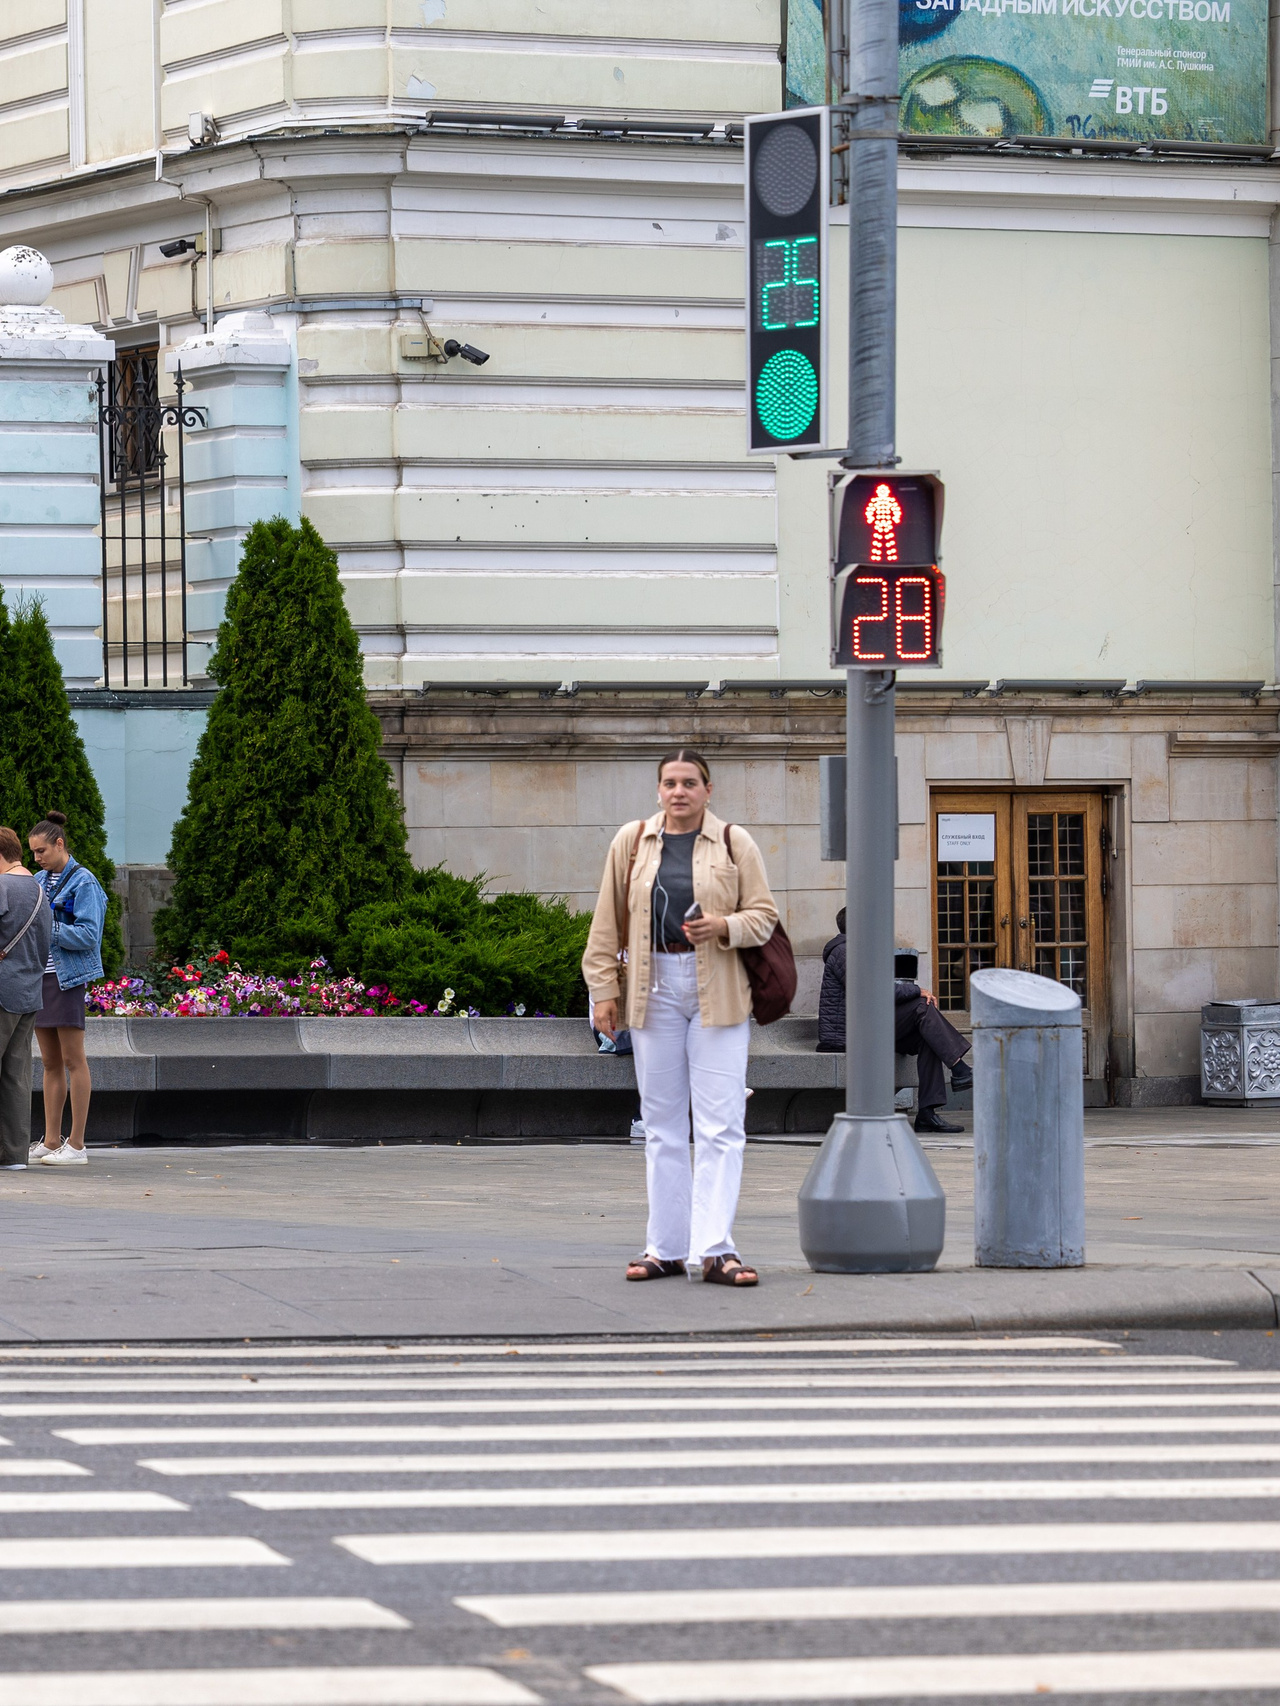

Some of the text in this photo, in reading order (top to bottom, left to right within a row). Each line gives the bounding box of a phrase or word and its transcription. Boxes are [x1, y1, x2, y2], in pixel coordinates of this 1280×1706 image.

[1062, 0, 1231, 23] ИСКУССТВОМ
[1117, 45, 1207, 60] Генеральный спонсор
[1117, 58, 1214, 72] ГМИИ им. А.С. Пушкина
[1115, 86, 1168, 116] ВТБ
[853, 576, 931, 660] 28
